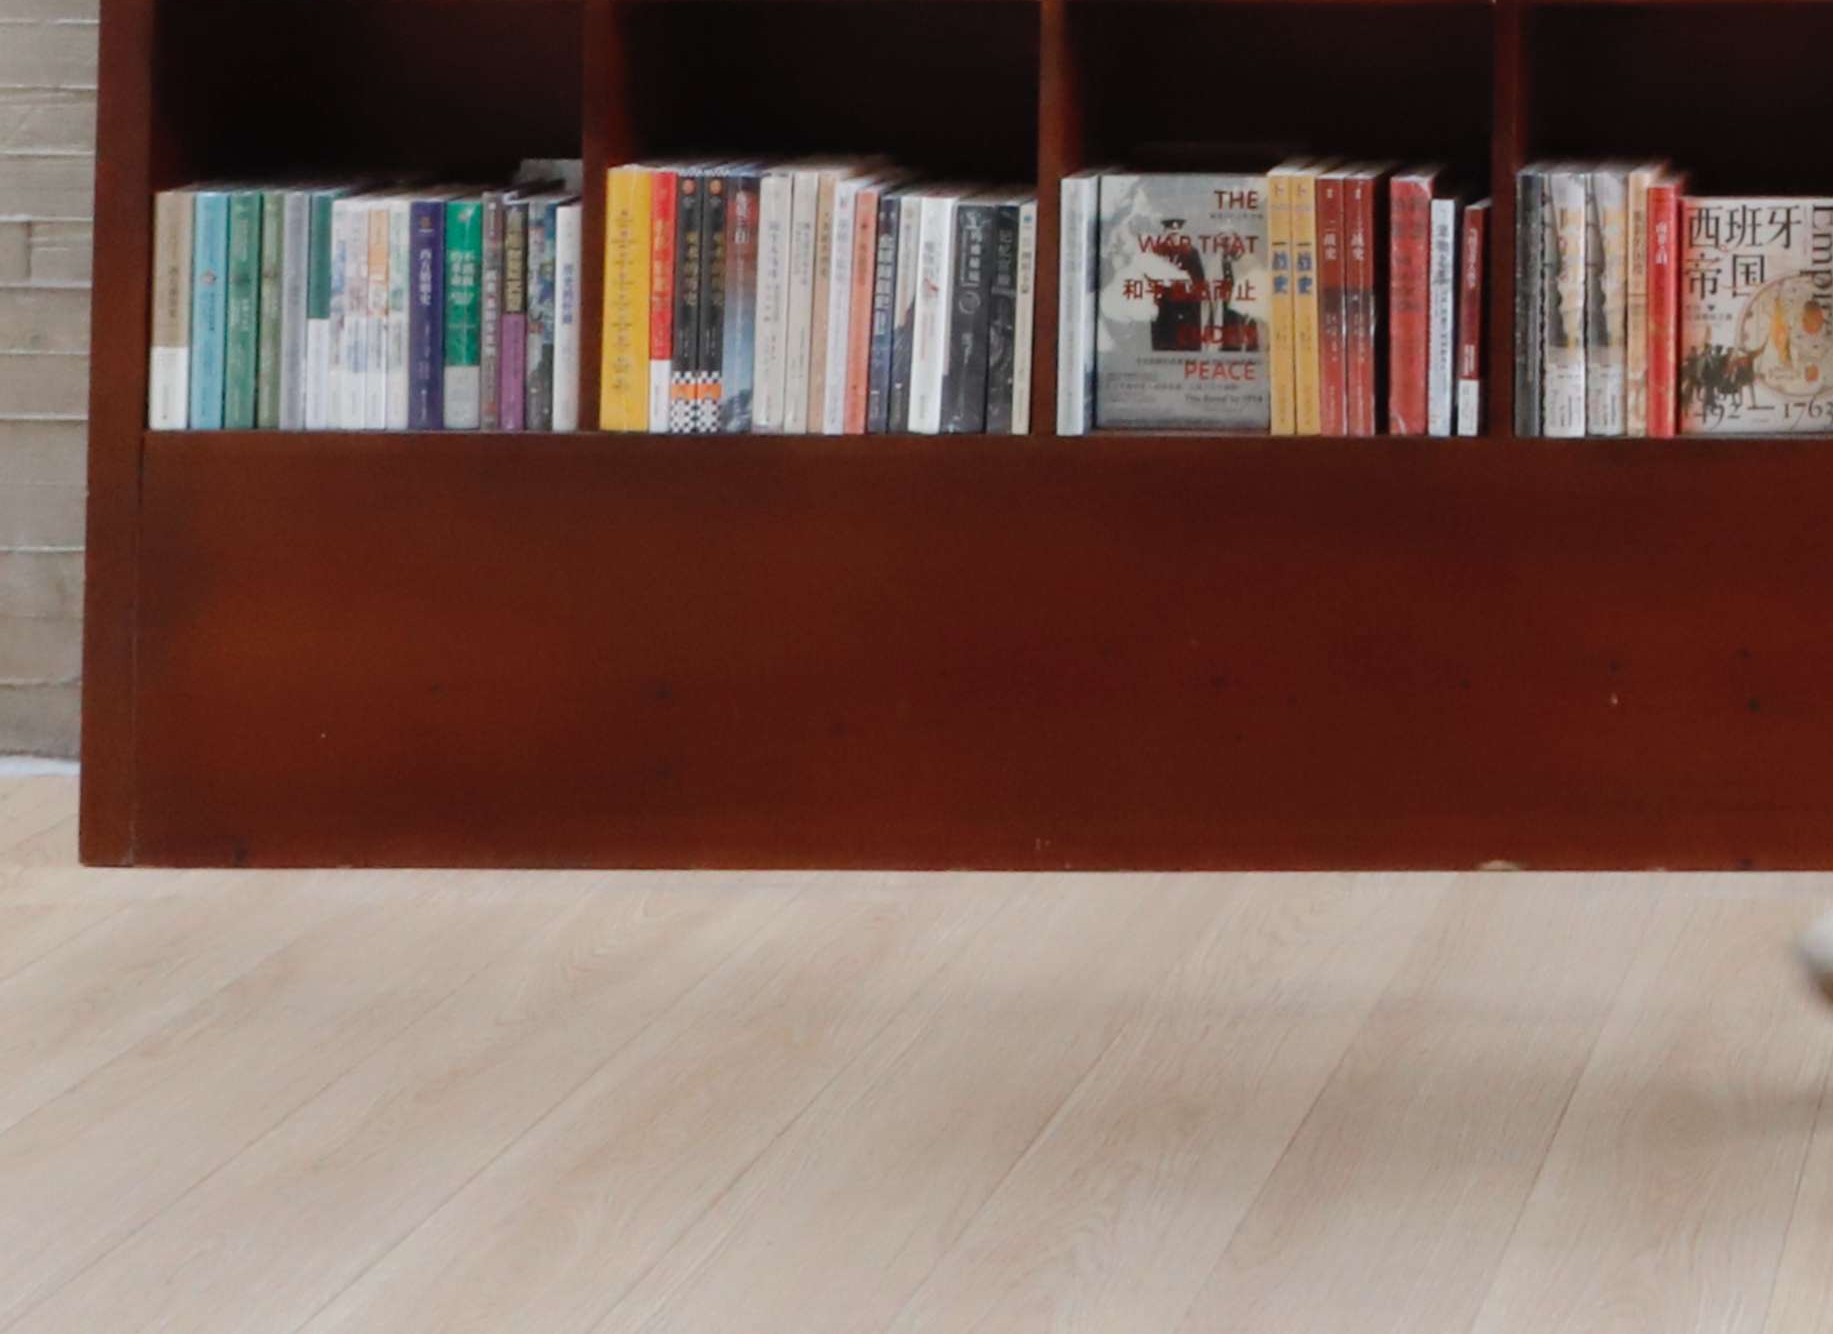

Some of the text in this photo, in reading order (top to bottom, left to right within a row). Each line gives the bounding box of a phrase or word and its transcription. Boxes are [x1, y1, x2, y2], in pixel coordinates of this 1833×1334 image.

[1213, 190, 1259, 212] THE
[1138, 234, 1259, 255] WAR THAT
[1688, 204, 1803, 251] 西班牙
[1271, 241, 1289, 296] 一战史
[1296, 241, 1313, 296] 一战史
[1685, 255, 1766, 302] 帝国
[1183, 360, 1256, 382] PEACE
